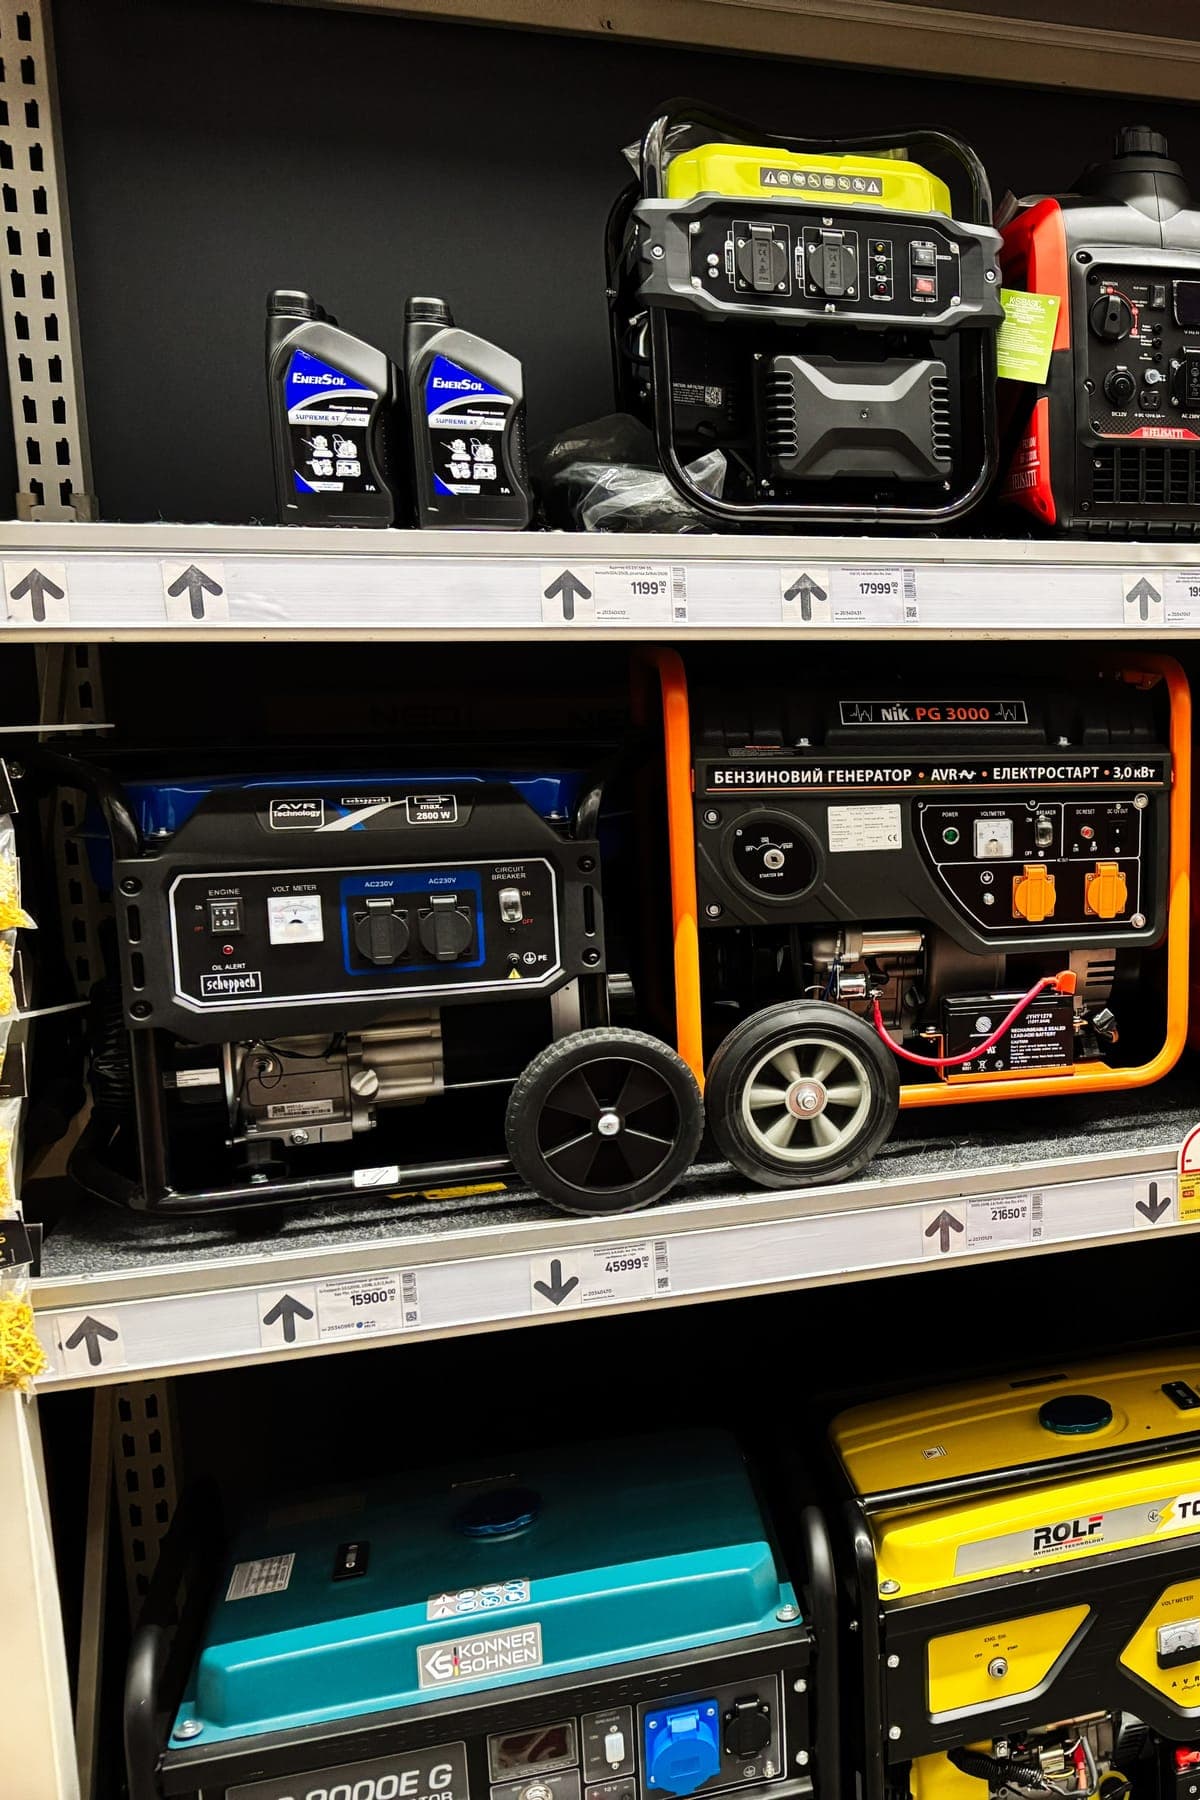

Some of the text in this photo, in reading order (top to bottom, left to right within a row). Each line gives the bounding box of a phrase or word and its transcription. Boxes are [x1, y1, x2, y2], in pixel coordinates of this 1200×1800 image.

[295, 413, 330, 423] SUPREME
[435, 418, 468, 426] SUPREME
[1150, 427, 1184, 439] FELISATTI
[631, 581, 659, 595] 1199
[859, 582, 891, 595] 17999
[915, 706, 941, 721] PG
[945, 706, 990, 721] 3000
[714, 765, 1156, 784] БЕНЗИНОВИЙ ГЕНЕРАТОР AVR ЕЛЕКТРОСТАРТ 3,0 кВт
[276, 802, 317, 811] AVR
[272, 810, 321, 818] Technology
[415, 811, 451, 820] 2800 W
[980, 810, 1006, 818] VOLTMETER
[1035, 809, 1057, 817] BREAKER
[428, 877, 457, 885] AC230V
[491, 872, 527, 881] BREAKER
[272, 884, 317, 893] VOLT METER
[364, 880, 394, 888] AC230V
[208, 888, 241, 897] ENGINE
[206, 973, 256, 993] scheppach
[991, 1208, 1020, 1221] 21650
[604, 1257, 642, 1273] 45999
[349, 1290, 388, 1307] 15900
[1033, 1515, 1104, 1551] ROLF
[1064, 1537, 1105, 1550] TECHNOLOGY
[1161, 1595, 1195, 1607] VOLT METER
[457, 1630, 536, 1659] KONNER
[459, 1646, 537, 1675] SOHNEN
[428, 1763, 453, 1790] G
